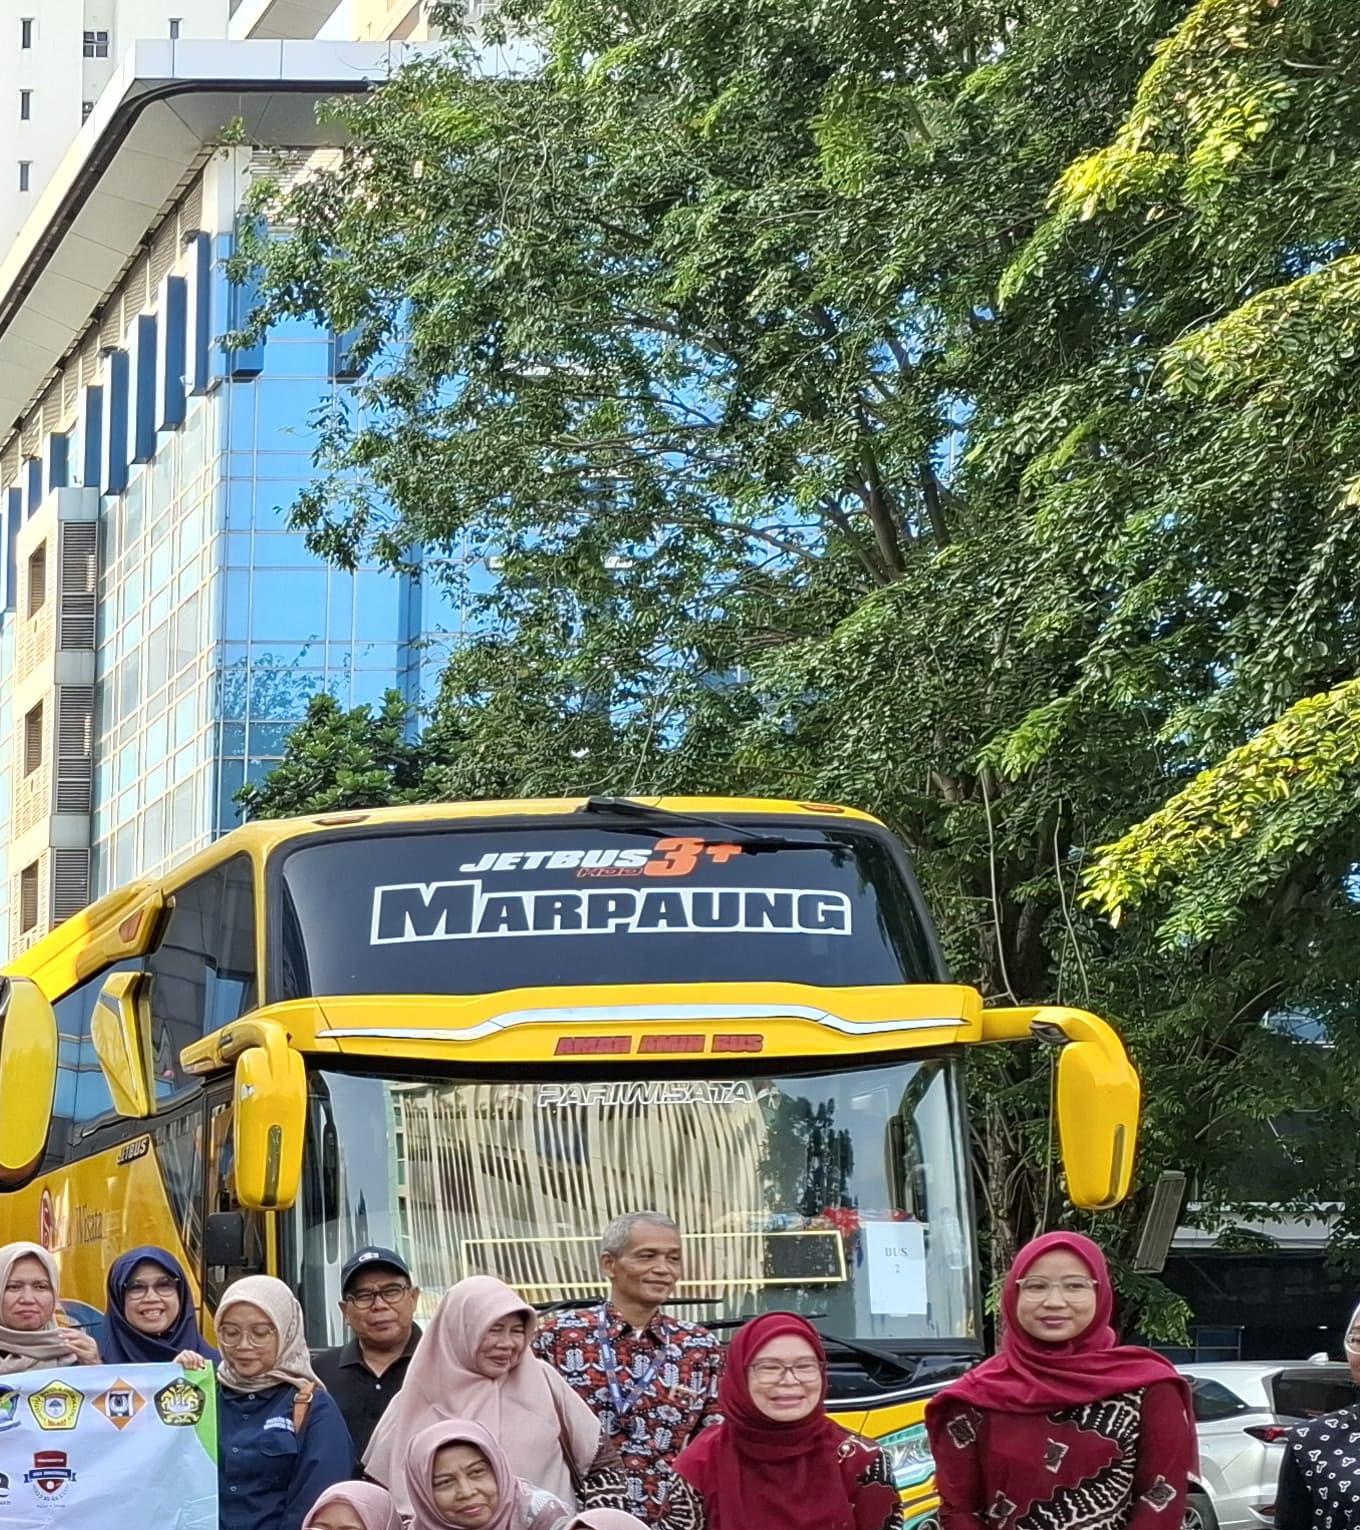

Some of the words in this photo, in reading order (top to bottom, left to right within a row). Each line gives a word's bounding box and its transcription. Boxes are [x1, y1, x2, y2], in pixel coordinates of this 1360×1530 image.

[459, 848, 653, 873] JETBUS
[370, 879, 853, 945] MARPAUNG
[537, 1080, 754, 1107] PARIWISATA
[885, 1248, 908, 1256] BUS
[895, 1264, 901, 1273] 2
